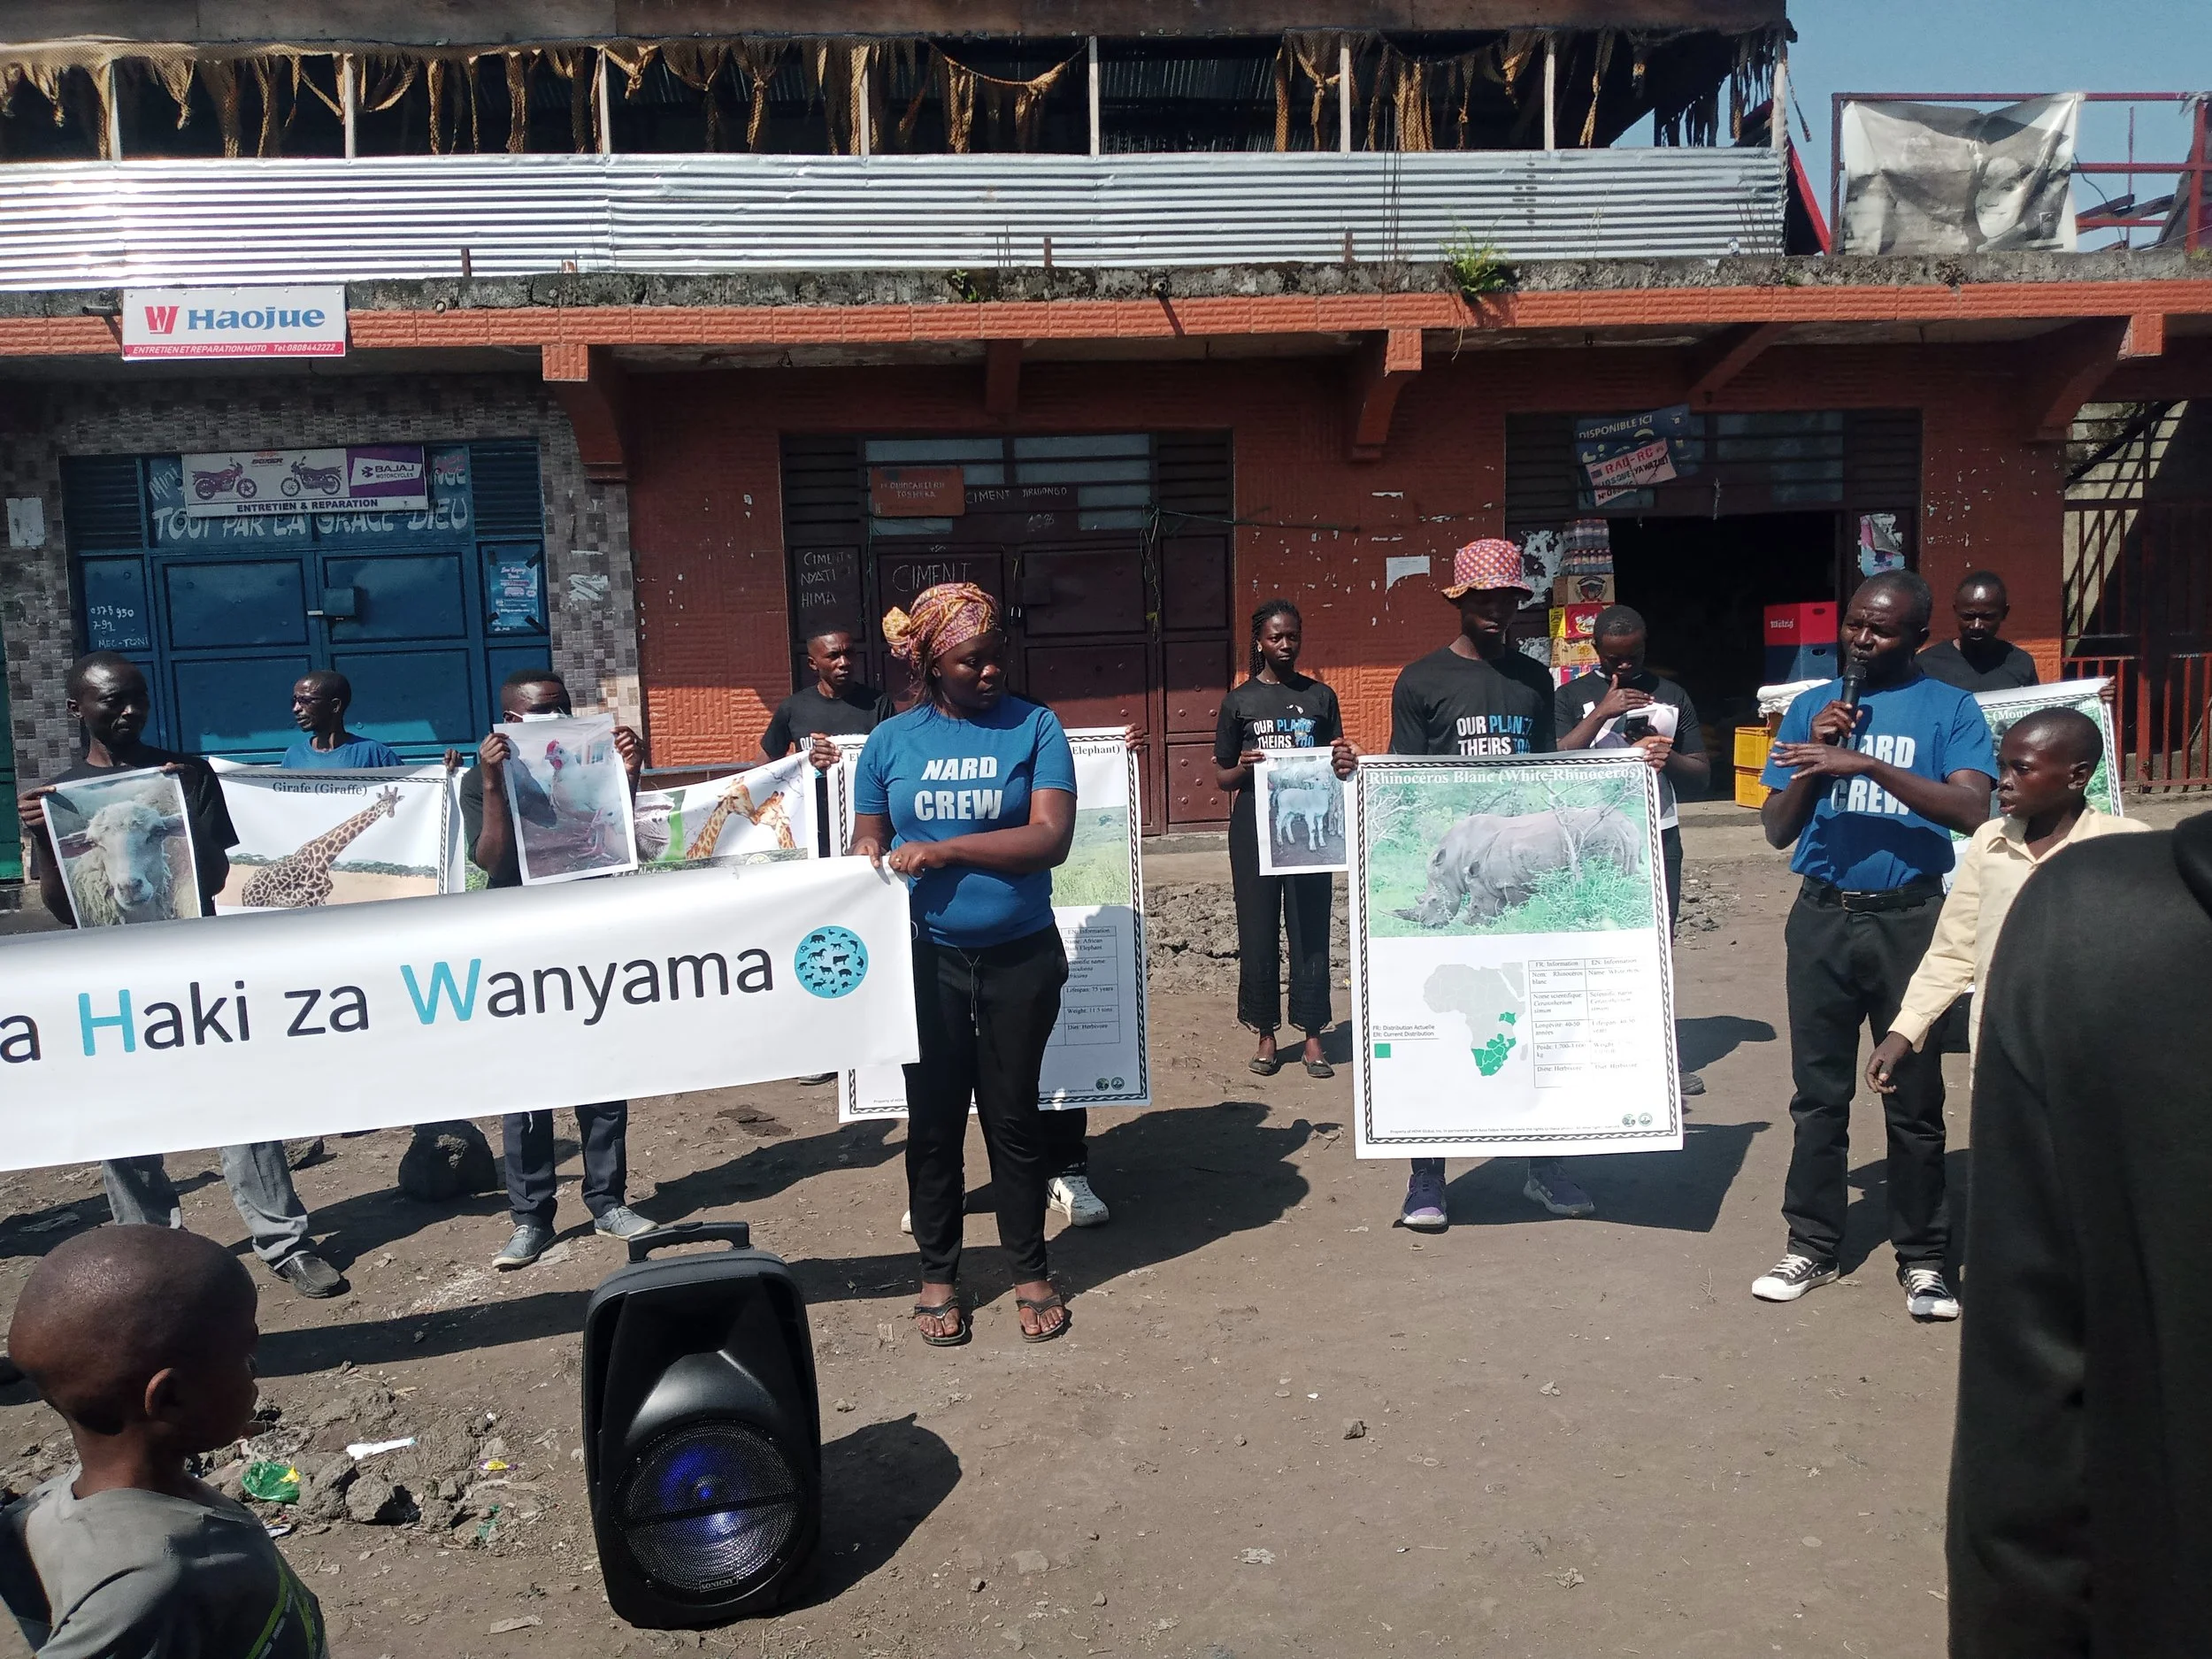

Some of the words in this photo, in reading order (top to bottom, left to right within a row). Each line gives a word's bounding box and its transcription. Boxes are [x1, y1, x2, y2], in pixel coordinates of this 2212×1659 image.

[188, 306, 326, 330] Haojue
[133, 345, 180, 354] ENTRETIEN
[188, 344, 245, 354] REPARATION
[1578, 419, 1637, 439] DISPONIBLE
[1639, 414, 1653, 426] ICI
[965, 489, 1010, 504] CIMENT
[237, 502, 296, 512] ENTRETIEN
[311, 499, 378, 510] REPARATION
[152, 507, 210, 540] TOUT
[223, 516, 265, 538] PAR
[273, 515, 306, 536] LA
[316, 512, 394, 534] GRACE
[407, 497, 468, 530] DIEU
[801, 569, 836, 586] NYATI
[892, 562, 972, 592] CIMENT
[801, 592, 836, 608] HIMA
[1253, 719, 1274, 735] OUR
[1456, 716, 1486, 736] OUR
[800, 737, 815, 750] OU
[1257, 735, 1292, 749] THEIRS
[1458, 736, 1511, 756] THEIRS
[920, 757, 998, 781] NARD
[1369, 770, 1448, 785] Rhinocéros
[1454, 770, 1494, 783] Blanc
[1498, 768, 1552, 783] (White
[273, 781, 311, 794] Girafe
[314, 782, 367, 797] (Giraffe)
[914, 789, 1002, 821] CREW
[78, 980, 250, 1056] Haki
[284, 985, 369, 1036] za
[400, 948, 774, 1026] Wanyama
